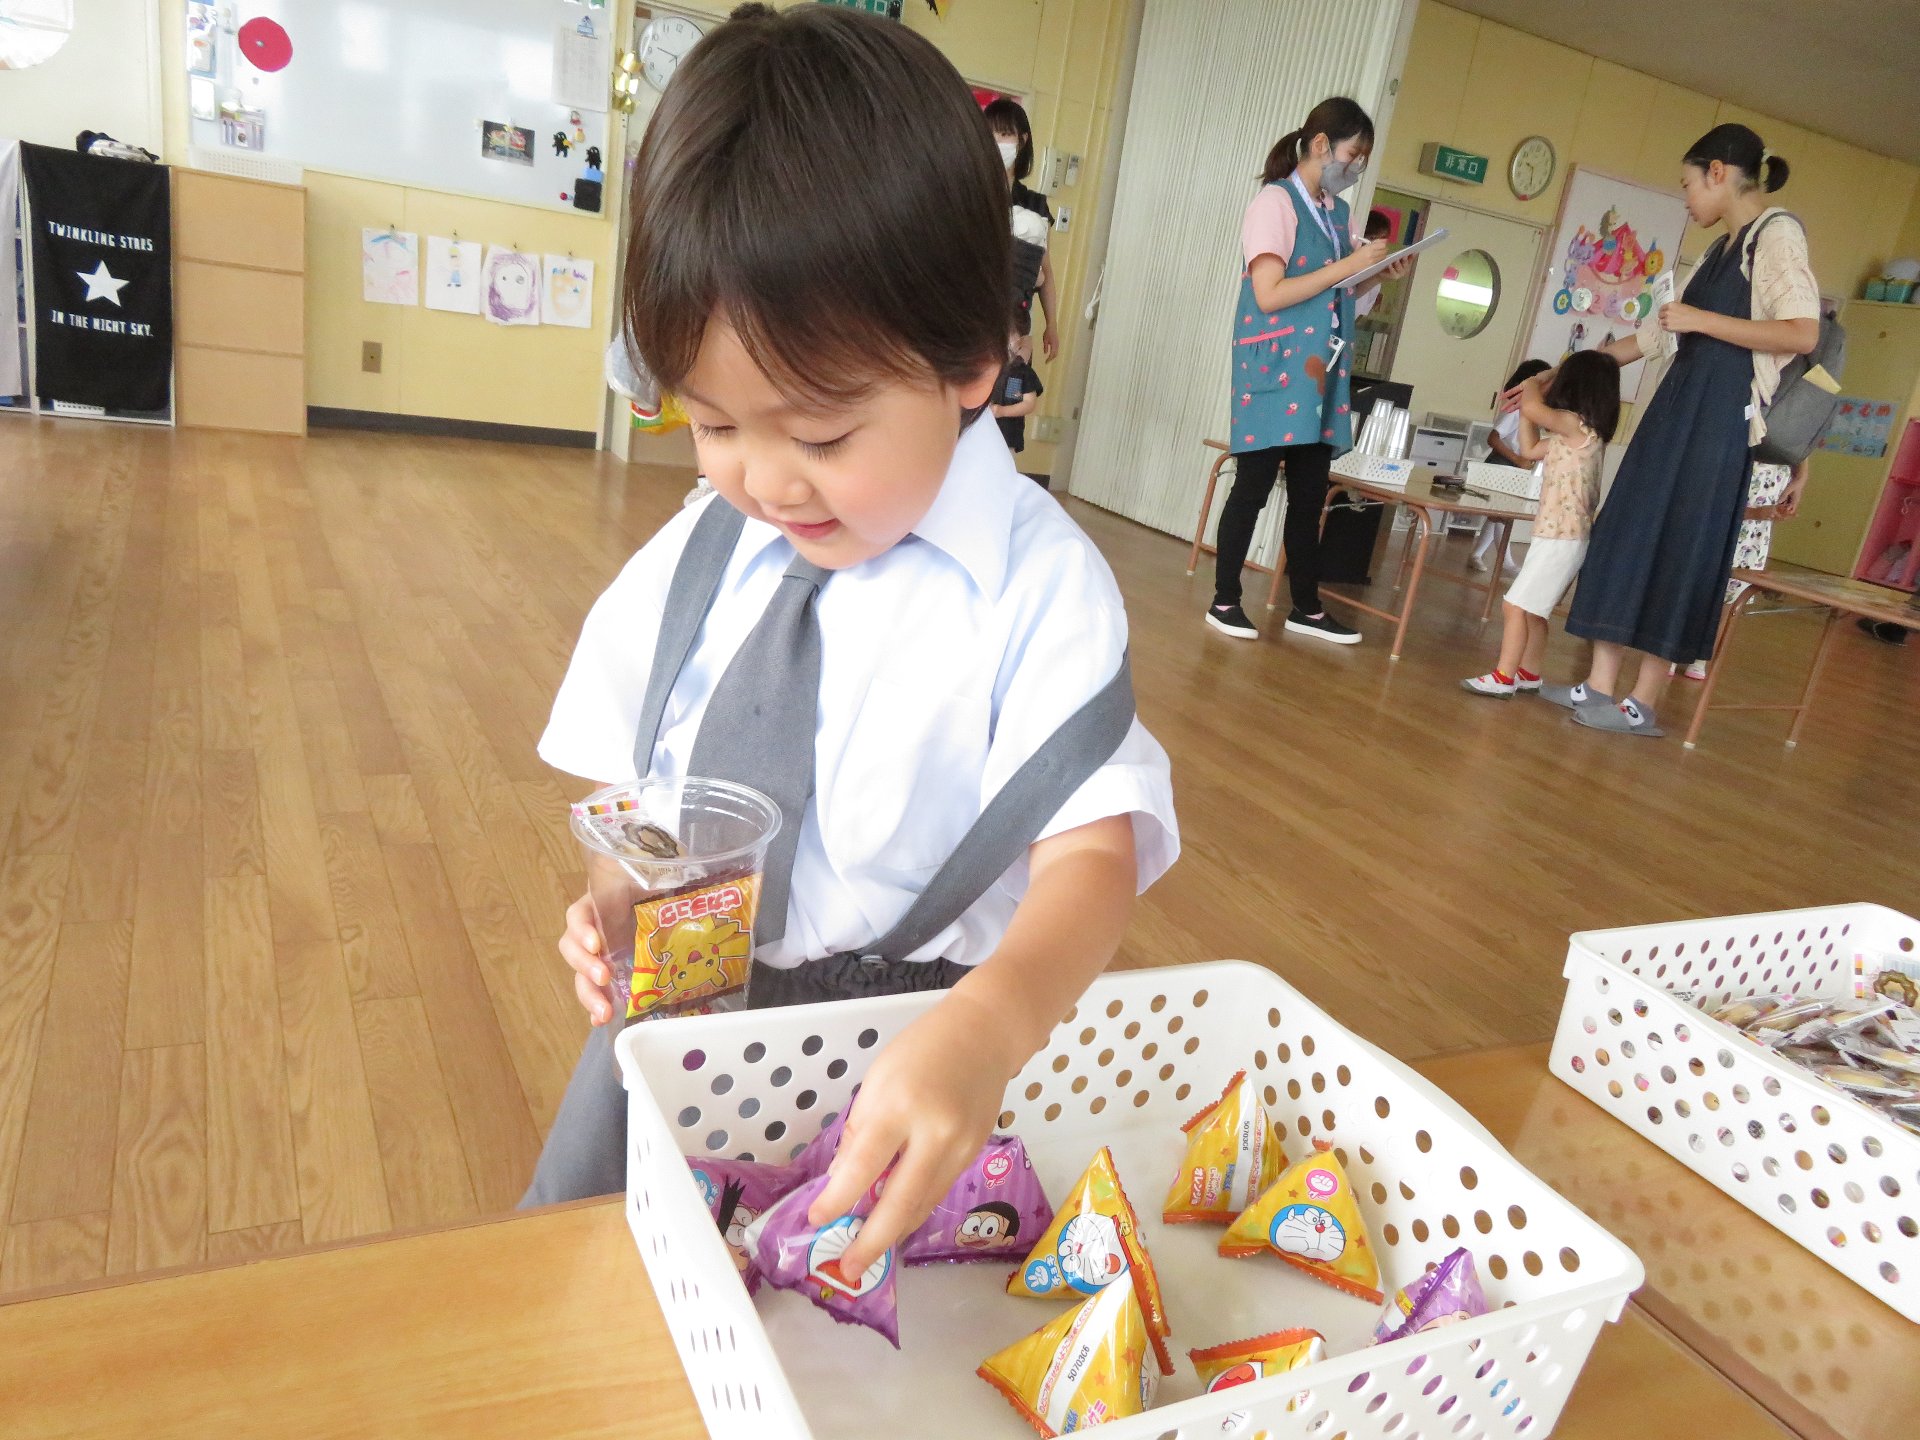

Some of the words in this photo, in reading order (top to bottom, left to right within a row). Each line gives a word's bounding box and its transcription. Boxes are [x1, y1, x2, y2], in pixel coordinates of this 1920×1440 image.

[1445, 155, 1478, 175] 非常口
[48, 220, 116, 247] TWINKLING
[119, 234, 154, 252] STARS
[51, 309, 65, 325] IN
[69, 313, 89, 329] THE
[92, 317, 127, 334] NIGHT
[659, 887, 742, 927] ピカチュウ
[1242, 1120, 1251, 1151] 50703C6
[1067, 1344, 1091, 1383] 50703C6
